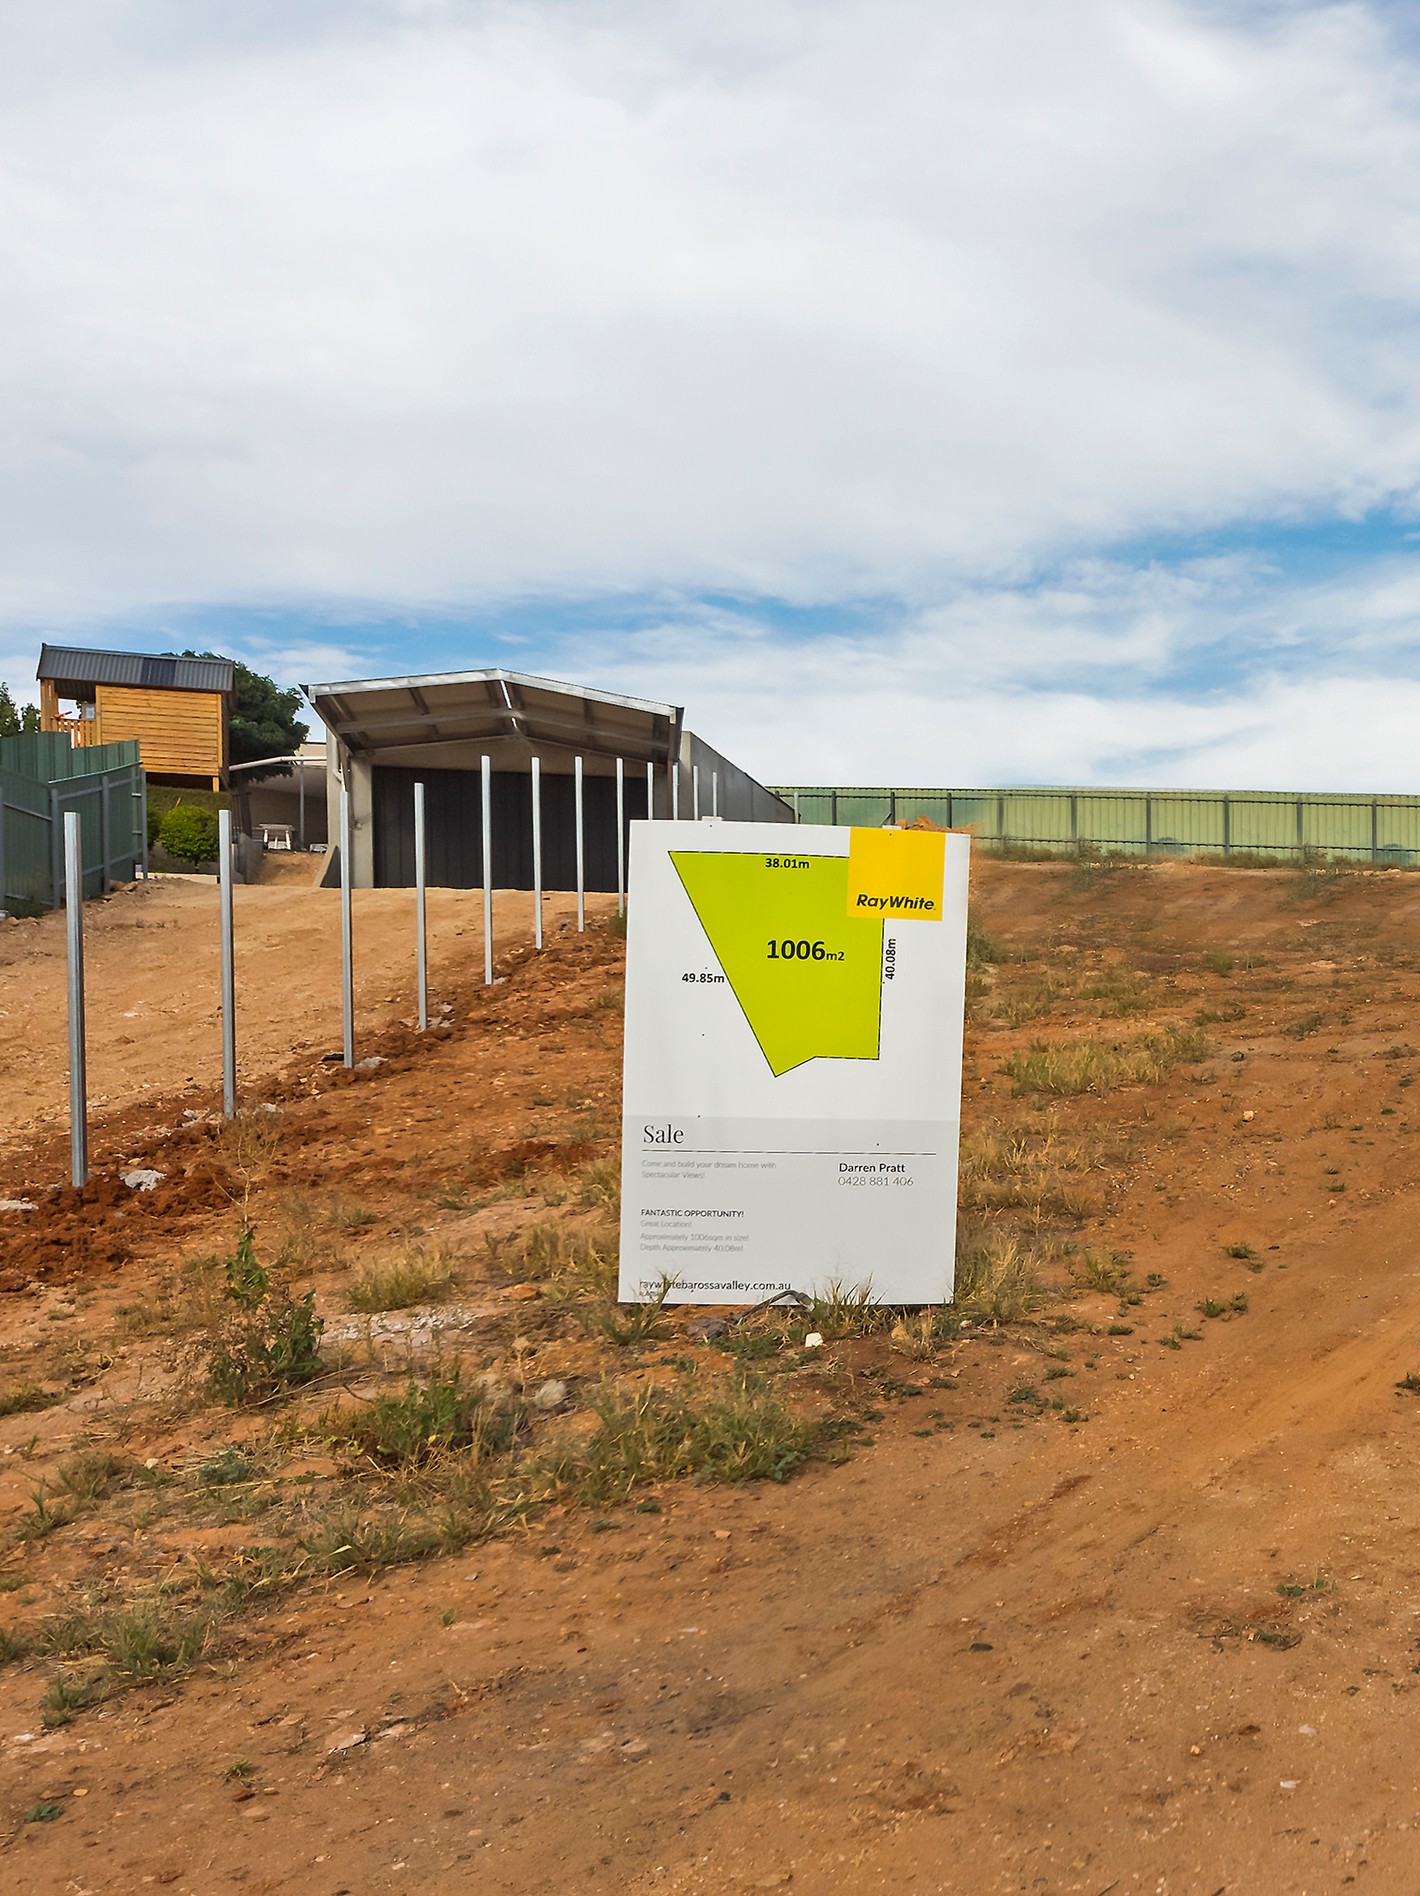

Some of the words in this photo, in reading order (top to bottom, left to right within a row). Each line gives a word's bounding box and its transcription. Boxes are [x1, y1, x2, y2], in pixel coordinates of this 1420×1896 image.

[765, 858, 810, 869] 38.01m
[885, 938, 896, 980] 40.08m
[681, 973, 725, 984] 49.85m
[643, 1124, 684, 1144] Sale
[641, 1160, 661, 1168] Come
[663, 1160, 676, 1168] and
[678, 1160, 695, 1168] build
[696, 1161, 712, 1170] your
[713, 1161, 737, 1169] dream
[738, 1161, 759, 1169] home
[839, 1163, 876, 1173] Darren
[879, 1163, 906, 1173] Pratt
[641, 1170, 680, 1180] Spectacular
[682, 1171, 705, 1179] Views!
[838, 1176, 866, 1187] 0428
[869, 1177, 889, 1187] 881
[892, 1177, 914, 1187] 406
[641, 1209, 683, 1217] FANTASTIC
[684, 1209, 744, 1218] OPPORTUNITY!
[640, 1220, 659, 1228] Great
[660, 1220, 692, 1228] Location!
[640, 1279, 791, 1292] raywtebarossavalley.com.au
